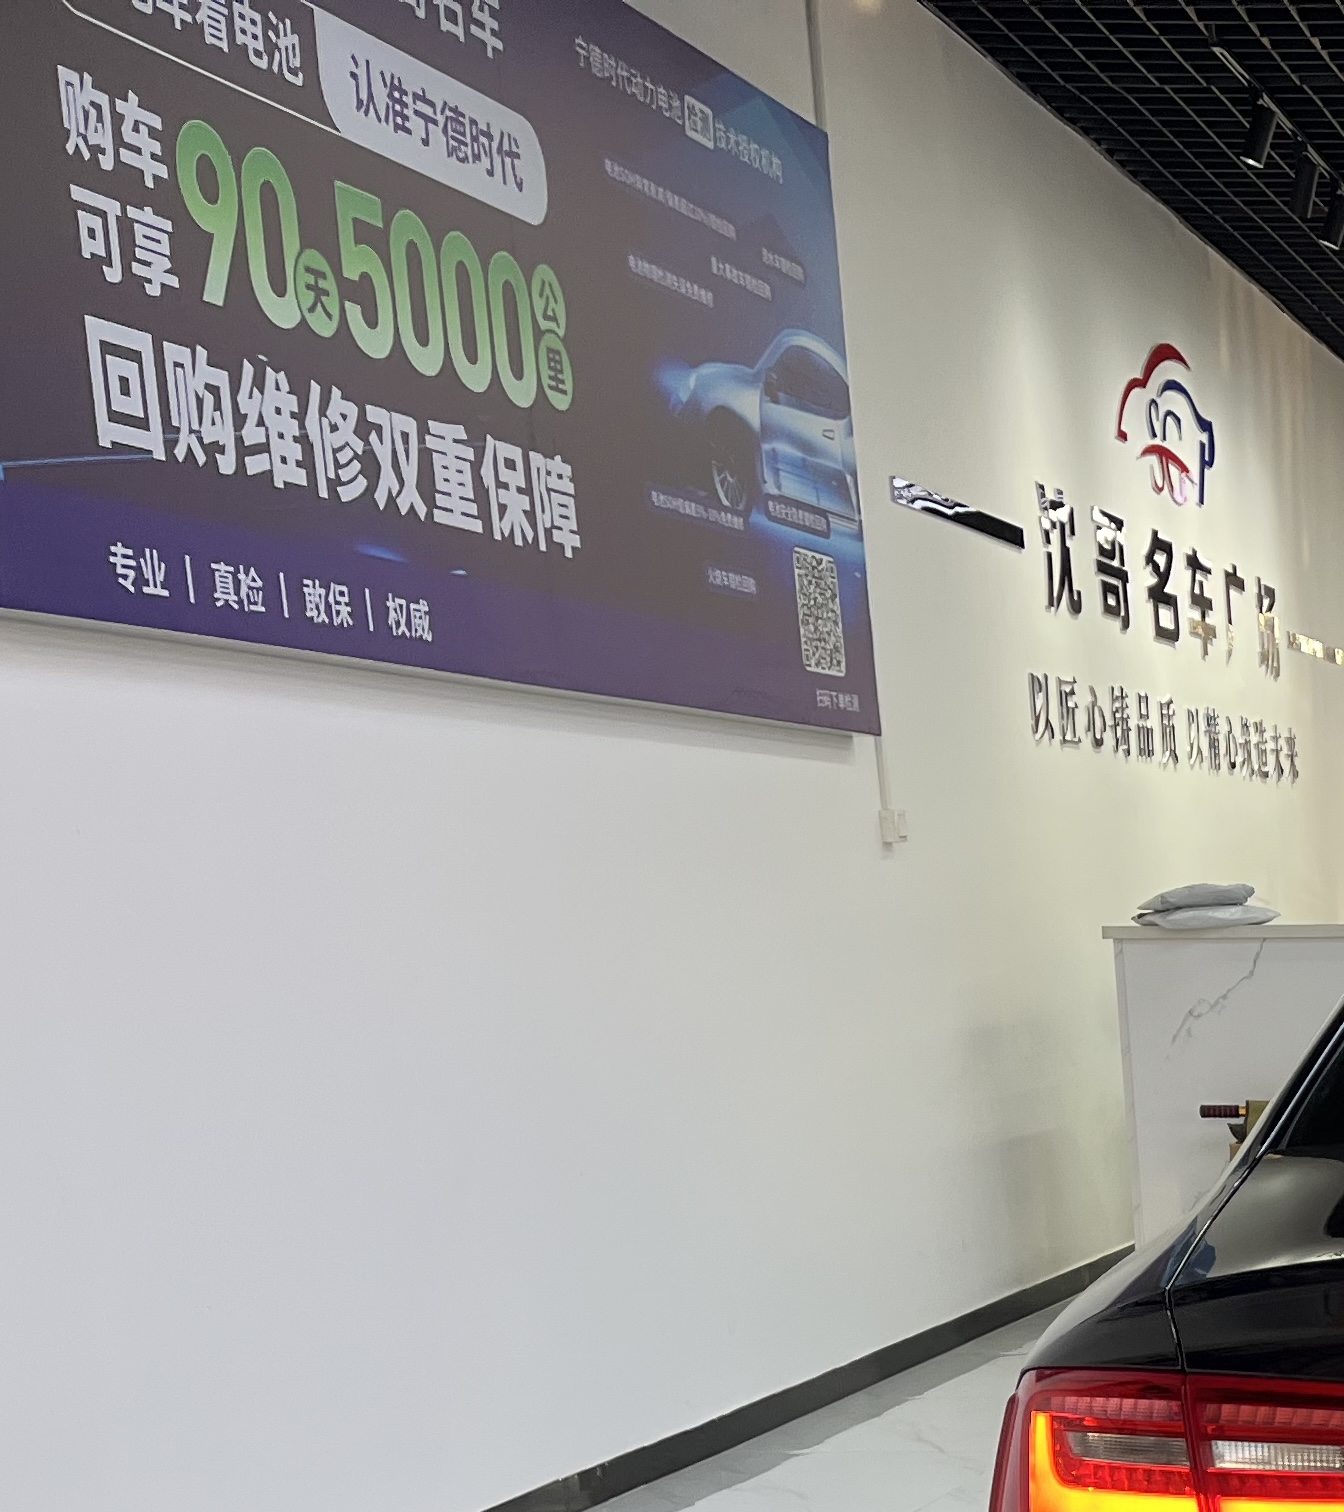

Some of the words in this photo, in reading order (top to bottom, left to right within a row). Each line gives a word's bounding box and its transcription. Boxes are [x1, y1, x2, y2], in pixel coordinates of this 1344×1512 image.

[57, 65, 169, 189] 购车
[350, 54, 524, 192] 认准宁德时代
[70, 184, 181, 297] 可享
[84, 315, 583, 559] 回购维修双重保障
[109, 541, 170, 598] 专业
[211, 561, 266, 614] 真检
[303, 578, 354, 628] 敢保
[386, 592, 433, 643] 权威
[1035, 481, 1281, 681] 沈哥名车广场
[1028, 673, 1179, 768] 以匠心铸品质
